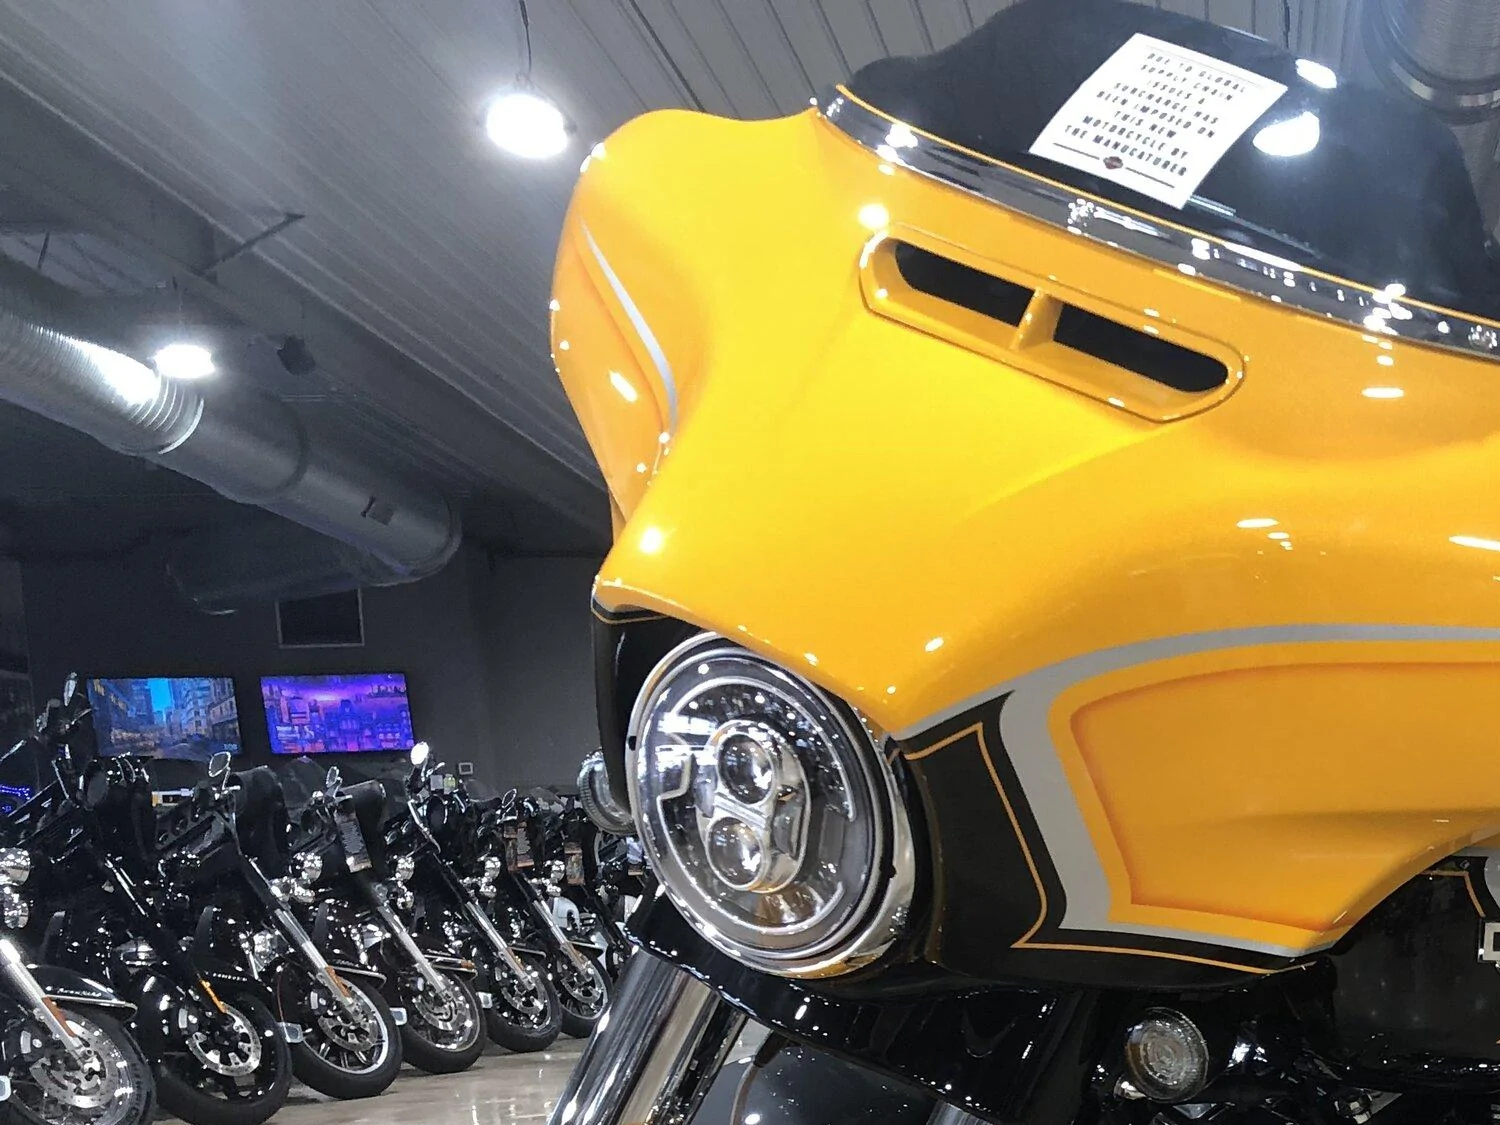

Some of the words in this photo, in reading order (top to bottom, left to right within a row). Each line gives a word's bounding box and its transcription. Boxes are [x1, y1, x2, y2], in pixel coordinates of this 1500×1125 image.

[1141, 64, 1188, 83] SUPPLY
[1193, 82, 1234, 102] CHAIN
[1146, 80, 1192, 100] ISSUES
[1147, 53, 1170, 65] DUE
[1179, 63, 1193, 73] TO
[1199, 71, 1245, 93] GLOBAL
[1096, 91, 1128, 106] BEEN
[1133, 103, 1192, 129] IMPOSED
[1197, 126, 1215, 138] ON
[1114, 82, 1188, 113] SURCHARGE
[1194, 111, 1220, 125] HAS
[1064, 125, 1088, 139] THE
[1082, 115, 1167, 152] MOTORCYCLE
[1170, 147, 1188, 160] BY
[1114, 110, 1144, 127] THIS
[1149, 124, 1177, 139] NEW
